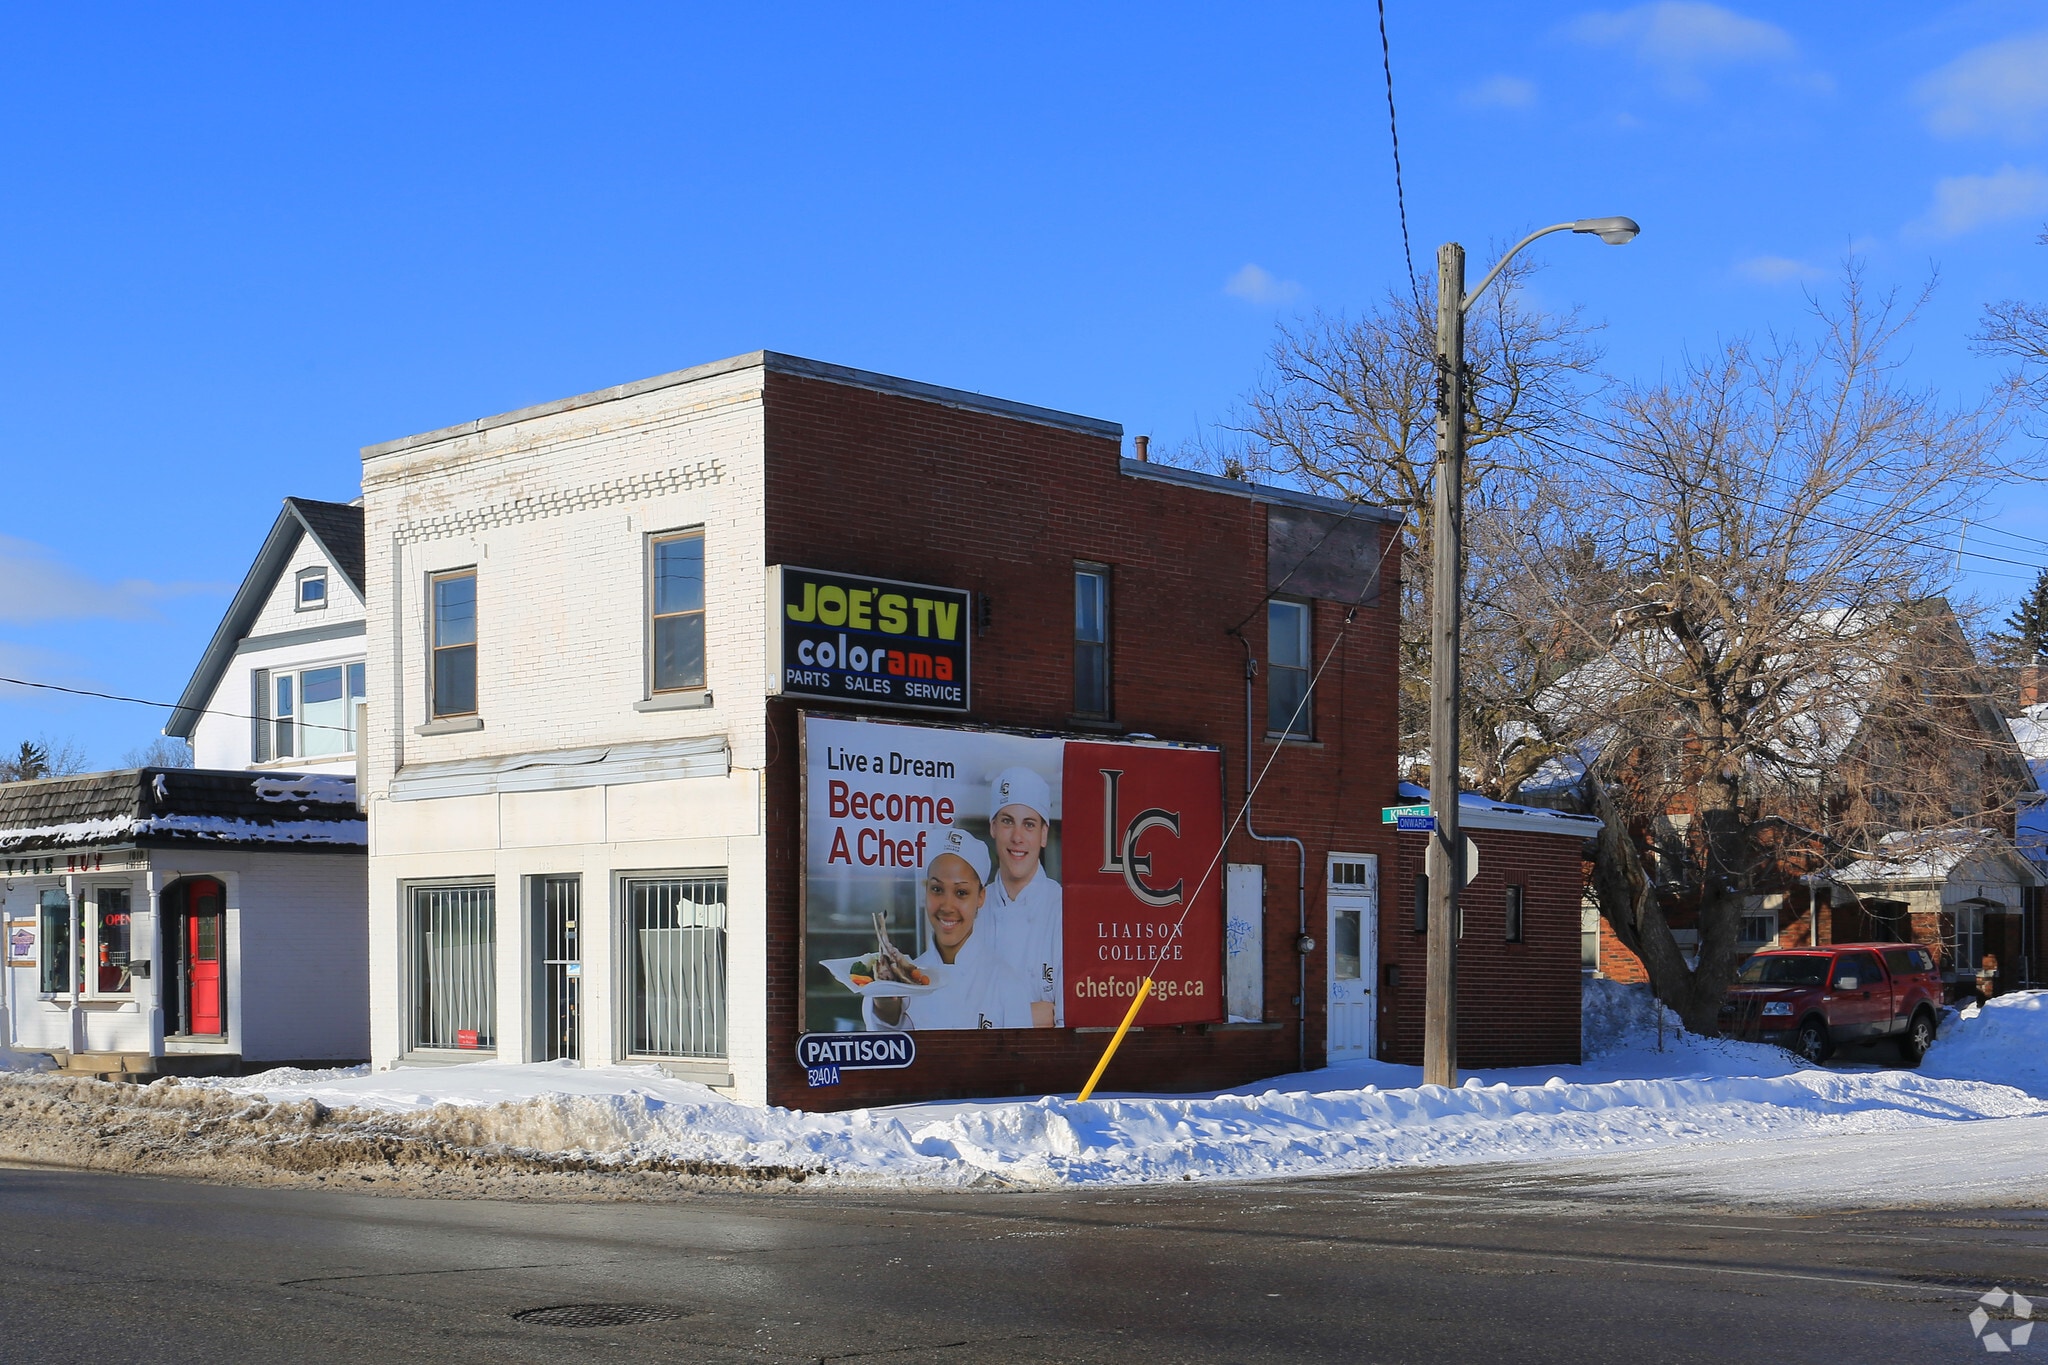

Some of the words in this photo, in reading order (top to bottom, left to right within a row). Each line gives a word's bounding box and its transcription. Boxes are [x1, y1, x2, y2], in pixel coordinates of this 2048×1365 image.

[786, 583, 908, 634] JOE'S
[912, 598, 959, 641] TV
[798, 633, 953, 681] colorama
[786, 669, 830, 688] PARTS
[845, 675, 891, 694] SALES
[905, 682, 961, 701] SERVICE
[827, 746, 867, 772] Live
[872, 756, 883, 774] a
[889, 752, 955, 779] Dream
[829, 779, 955, 825] Become
[1400, 818, 1427, 828] ONWARD
[827, 826, 852, 865] A
[857, 828, 927, 868] Chef
[105, 913, 132, 926] OPEN
[1098, 923, 1184, 938] LIAISON
[1098, 945, 1184, 960] COLLEGE
[807, 1039, 906, 1063] PATTISON
